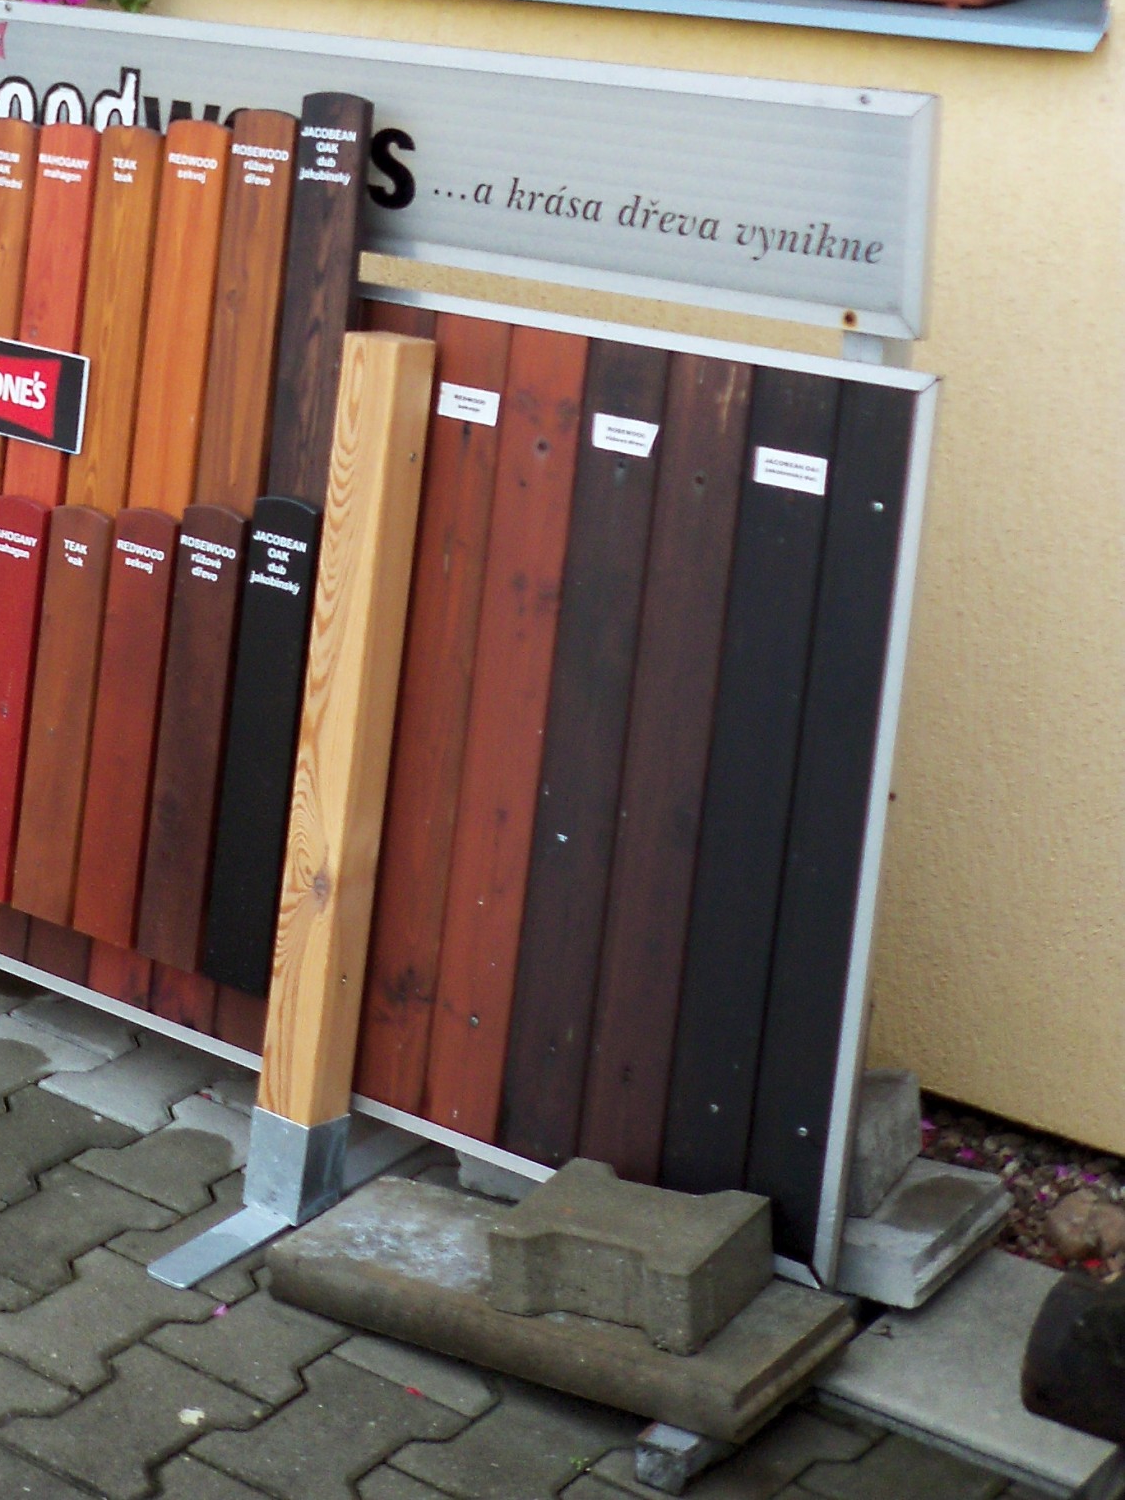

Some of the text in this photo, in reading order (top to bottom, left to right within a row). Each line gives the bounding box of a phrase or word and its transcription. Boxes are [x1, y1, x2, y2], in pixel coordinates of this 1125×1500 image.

[301, 126, 357, 142] JACOBEAN
[231, 143, 290, 161] ROSEWOOD
[315, 141, 339, 154] OAK
[39, 153, 90, 170] MAHOGANY
[112, 157, 137, 170] TEAK
[168, 152, 218, 170] REDWOOD
[316, 155, 336, 167] dub
[507, 177, 603, 222] krása
[618, 195, 721, 241] dřeva
[736, 222, 885, 263] vynikne
[64, 538, 88, 555] TEAK
[116, 539, 165, 561] REDWOOD
[180, 534, 236, 560] ROSEWOOD
[253, 530, 307, 553] JACOBEAN
[65, 553, 83, 567] eak
[267, 547, 290, 562] OAK
[267, 562, 287, 575] dub
